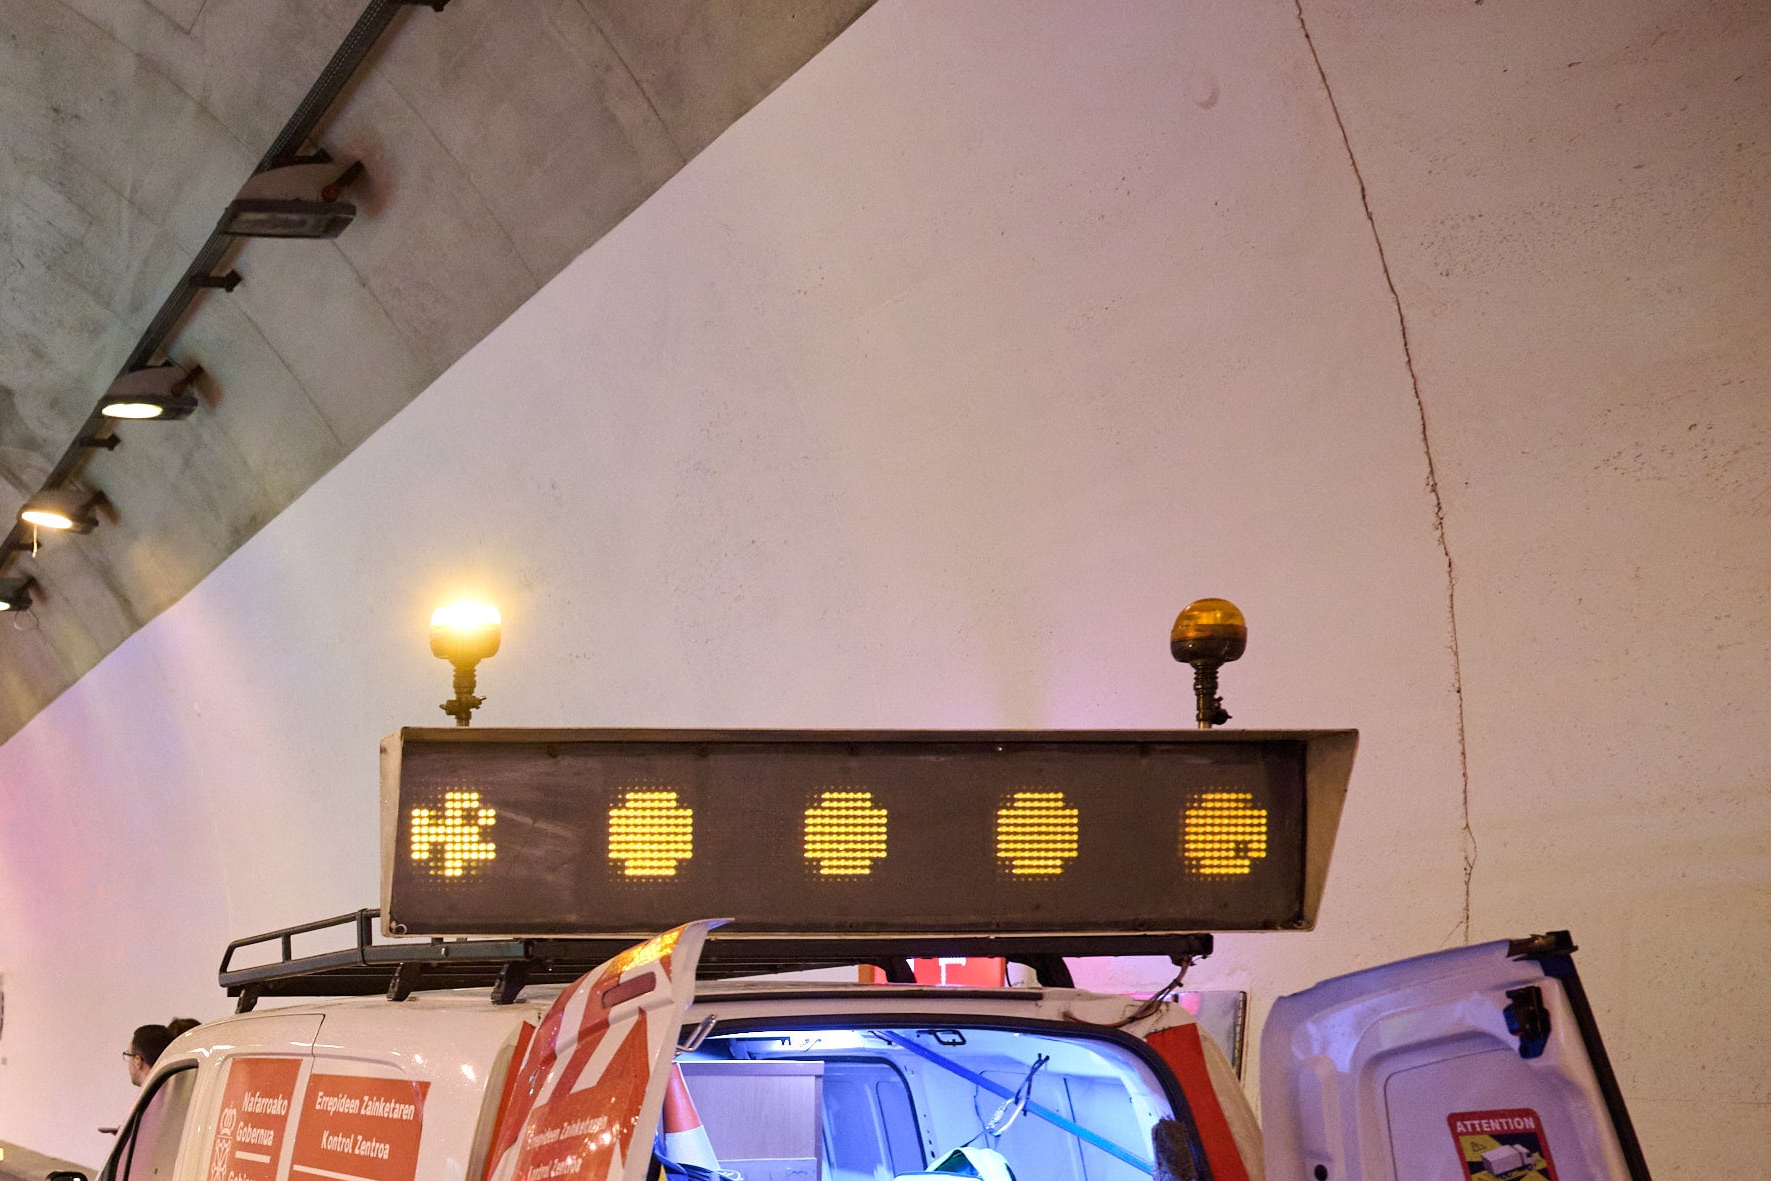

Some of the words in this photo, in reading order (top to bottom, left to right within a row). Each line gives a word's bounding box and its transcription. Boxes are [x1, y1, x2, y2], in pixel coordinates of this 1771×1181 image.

[242, 1091, 288, 1116] Nafarroako
[315, 1091, 359, 1116] Errepideen
[360, 1095, 415, 1121] Zainketaren
[236, 1120, 274, 1147] Gobernua
[1456, 1117, 1535, 1133] ATTENTION
[321, 1130, 352, 1153] Kontrol
[354, 1135, 390, 1160] Zentroa
